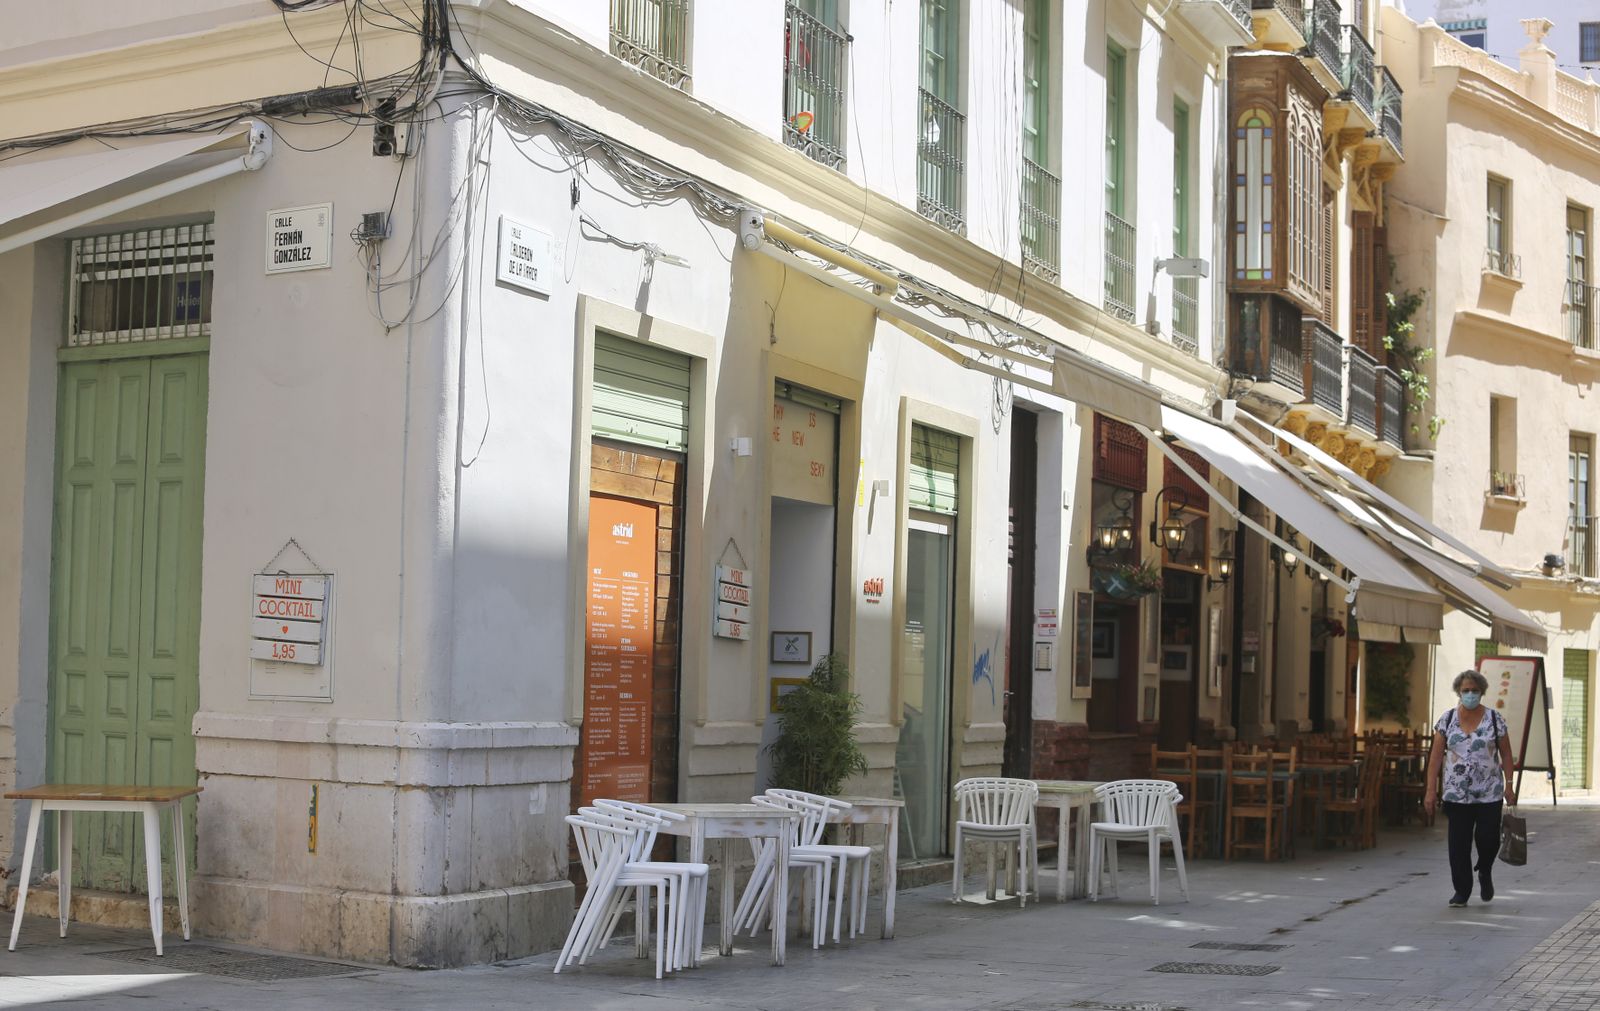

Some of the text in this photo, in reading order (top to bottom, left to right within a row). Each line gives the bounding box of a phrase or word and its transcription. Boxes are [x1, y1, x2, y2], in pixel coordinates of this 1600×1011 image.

[275, 217, 292, 228] CALLE
[274, 229, 303, 247] FERNÁN
[274, 246, 312, 264] GONZÁLEZ
[612, 522, 633, 538] astrid
[730, 569, 744, 585] MINI
[275, 578, 303, 595] MINI
[723, 585, 750, 603] COCKTAIL
[258, 599, 316, 618] COCKTAIL
[272, 643, 296, 660] 1,95
